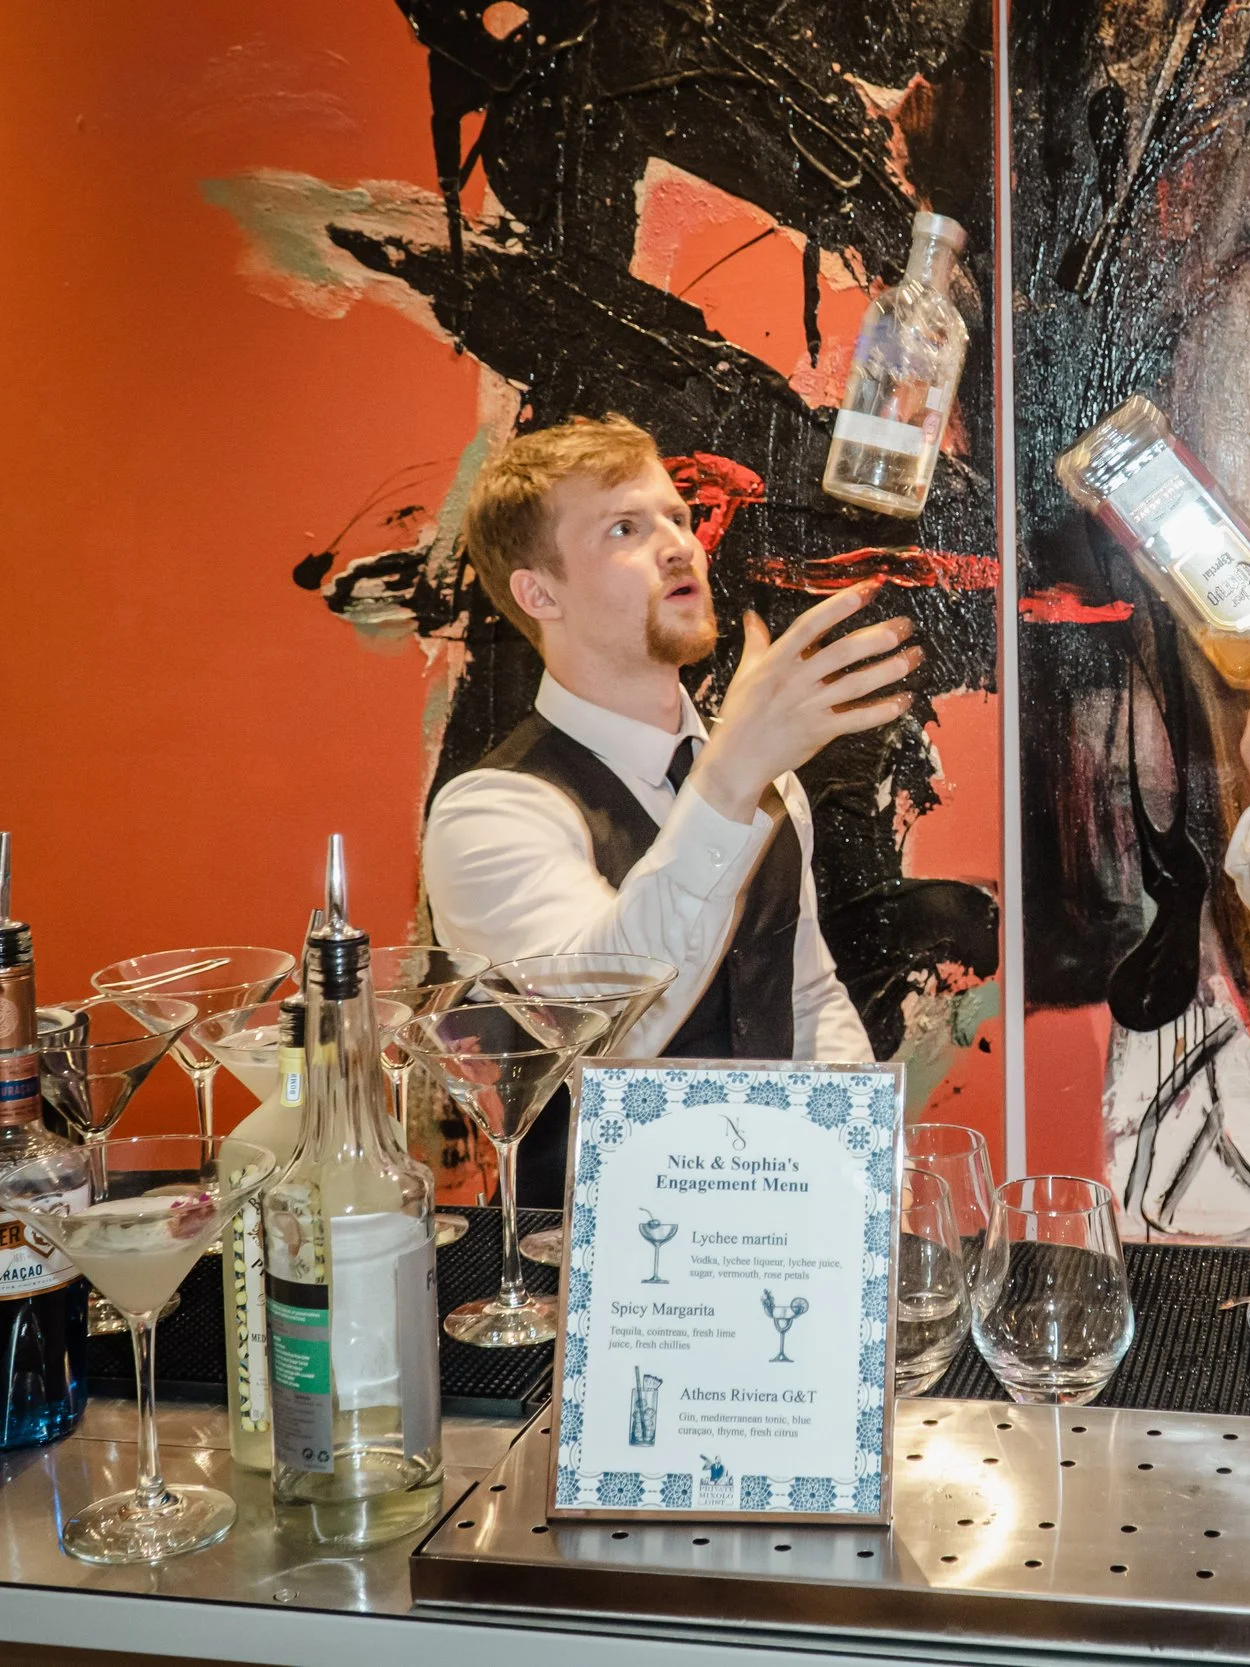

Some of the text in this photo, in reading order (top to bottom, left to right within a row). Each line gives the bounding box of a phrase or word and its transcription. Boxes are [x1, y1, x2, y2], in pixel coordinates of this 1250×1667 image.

[1203, 552, 1236, 581] Especial
[668, 1155, 800, 1174] Nick & Sophia's
[656, 1175, 809, 1194] Engagement Menu
[692, 1231, 788, 1246] Lychee martini
[691, 1255, 843, 1269] Vodka, lychee liqueur, lychee juice,
[0, 1264, 43, 1281] RAÇAO
[690, 1270, 715, 1280] sugar,
[718, 1270, 761, 1280] vermouth,
[784, 1271, 810, 1281] petals
[611, 1301, 715, 1319] Spicy Margarita
[610, 1326, 736, 1338] Tequila, cointreau, fresh lime
[608, 1339, 690, 1350] juice, fresh chillies
[680, 1388, 817, 1403] Athens Riviera G&T
[678, 1412, 812, 1425] Gin, mediterranean tonic, blue
[678, 1427, 798, 1438] curaçao, thyme, fresh citrus
